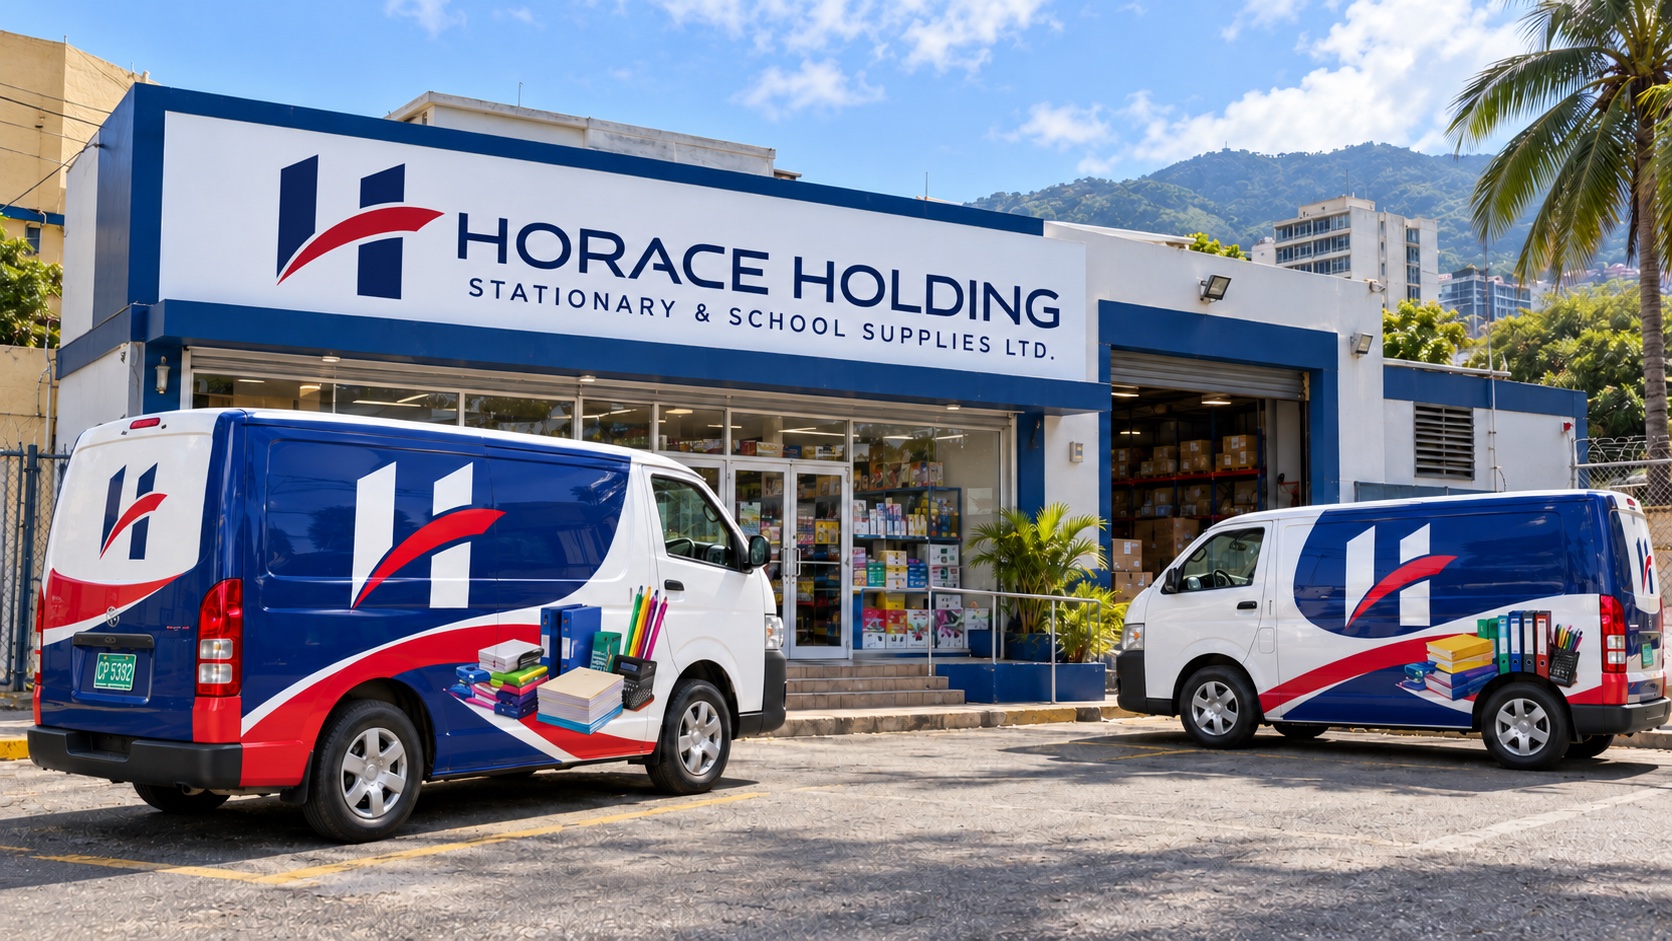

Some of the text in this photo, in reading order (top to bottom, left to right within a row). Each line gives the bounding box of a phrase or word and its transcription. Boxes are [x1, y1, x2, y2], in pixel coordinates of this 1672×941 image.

[457, 212, 1061, 330] HORACE HOLDING
[468, 277, 1056, 360] STATIONARY & SCHOOL SUPPLIES LTD.
[97, 662, 109, 680] CP
